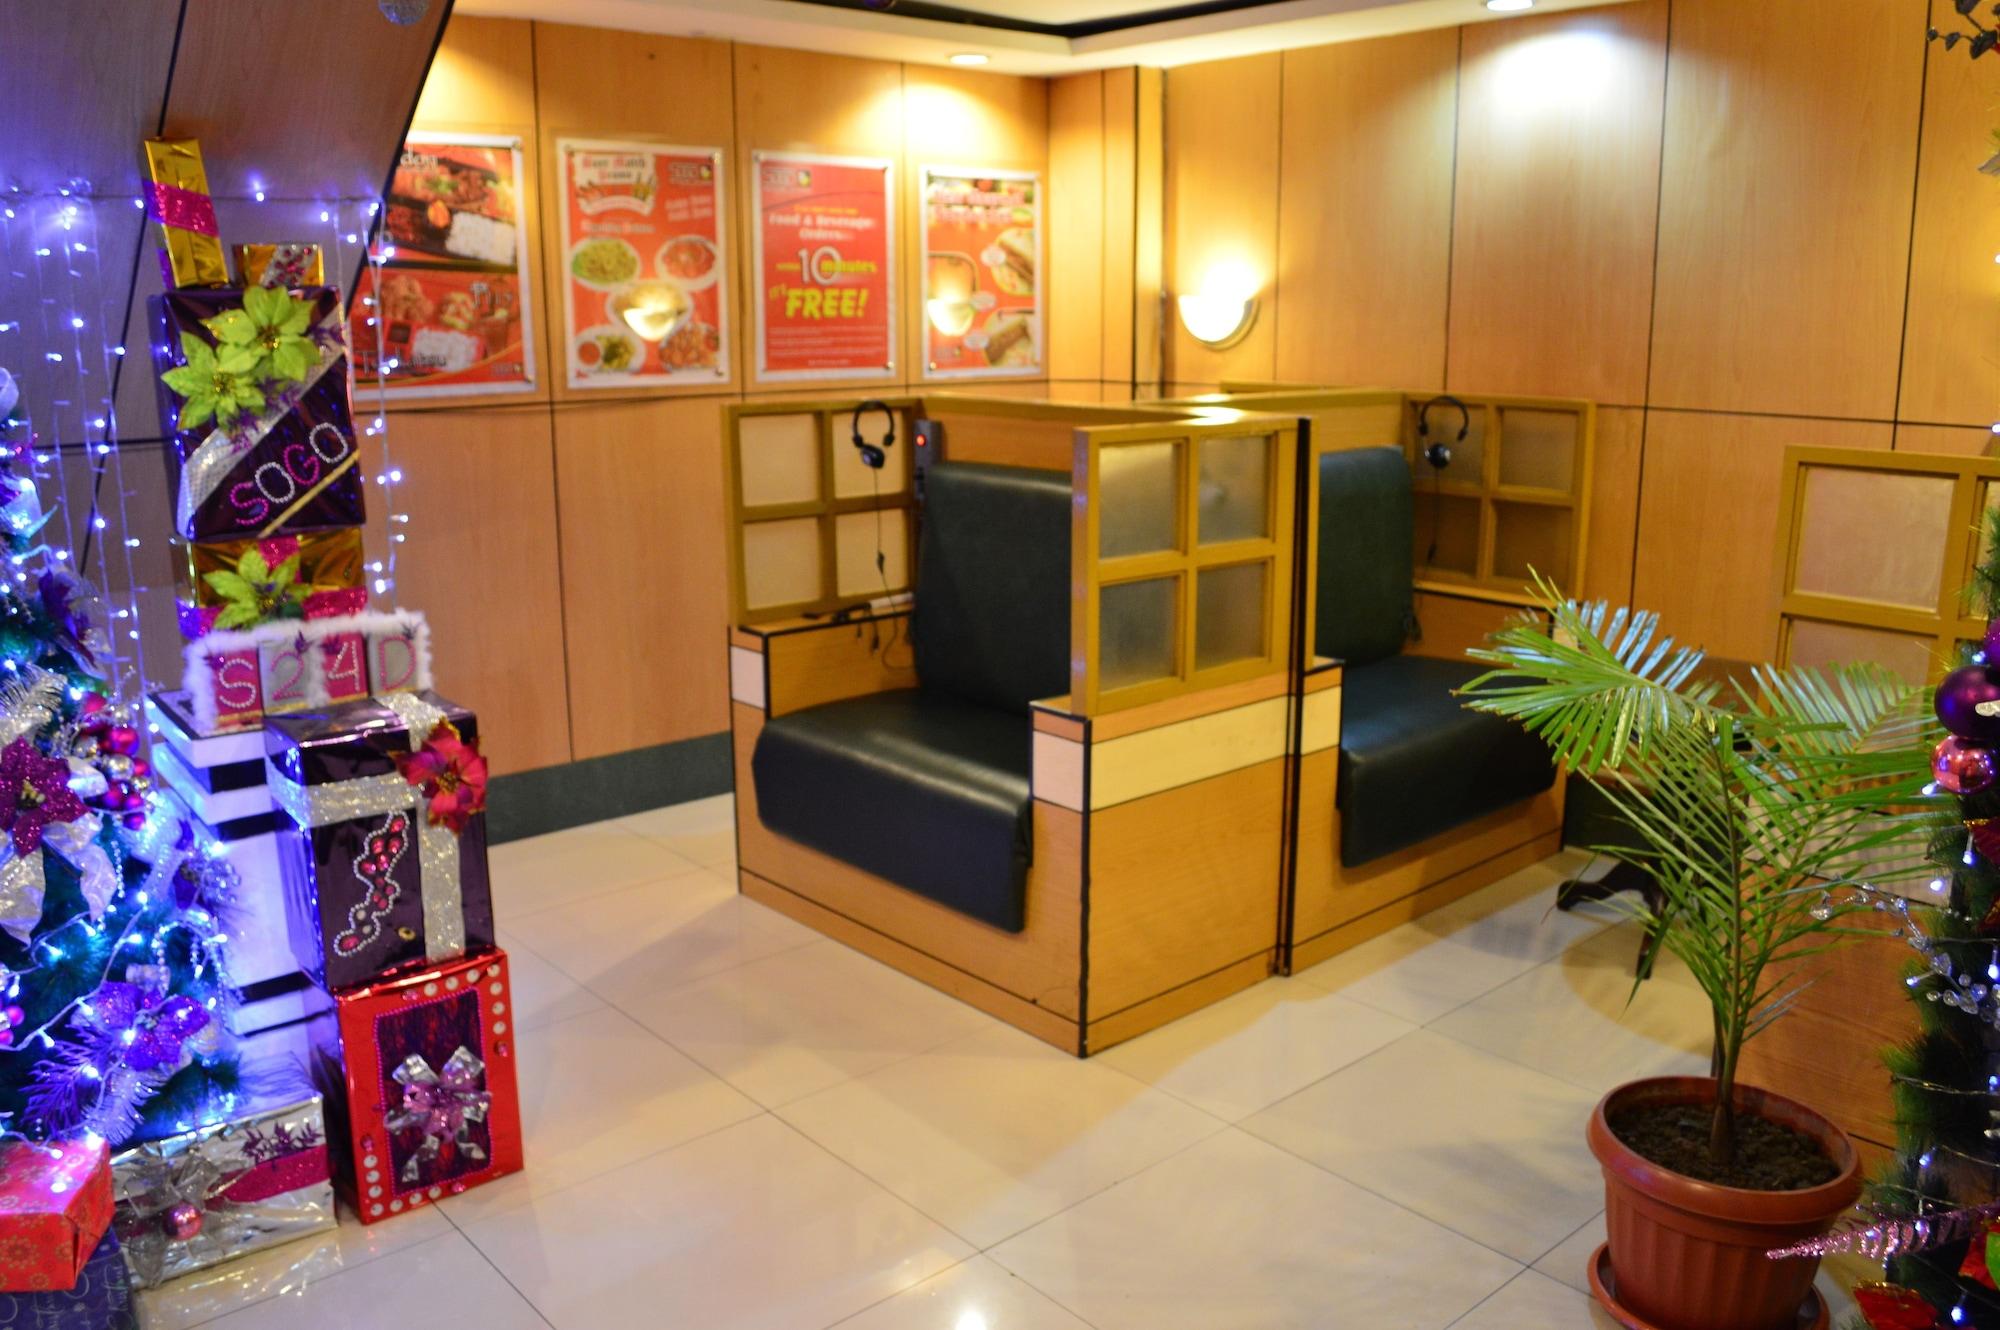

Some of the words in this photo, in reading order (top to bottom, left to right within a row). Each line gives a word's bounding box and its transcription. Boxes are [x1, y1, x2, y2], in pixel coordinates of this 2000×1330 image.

[798, 246, 842, 286] 10
[785, 287, 869, 319] FREE!
[230, 422, 348, 526] SOGO
